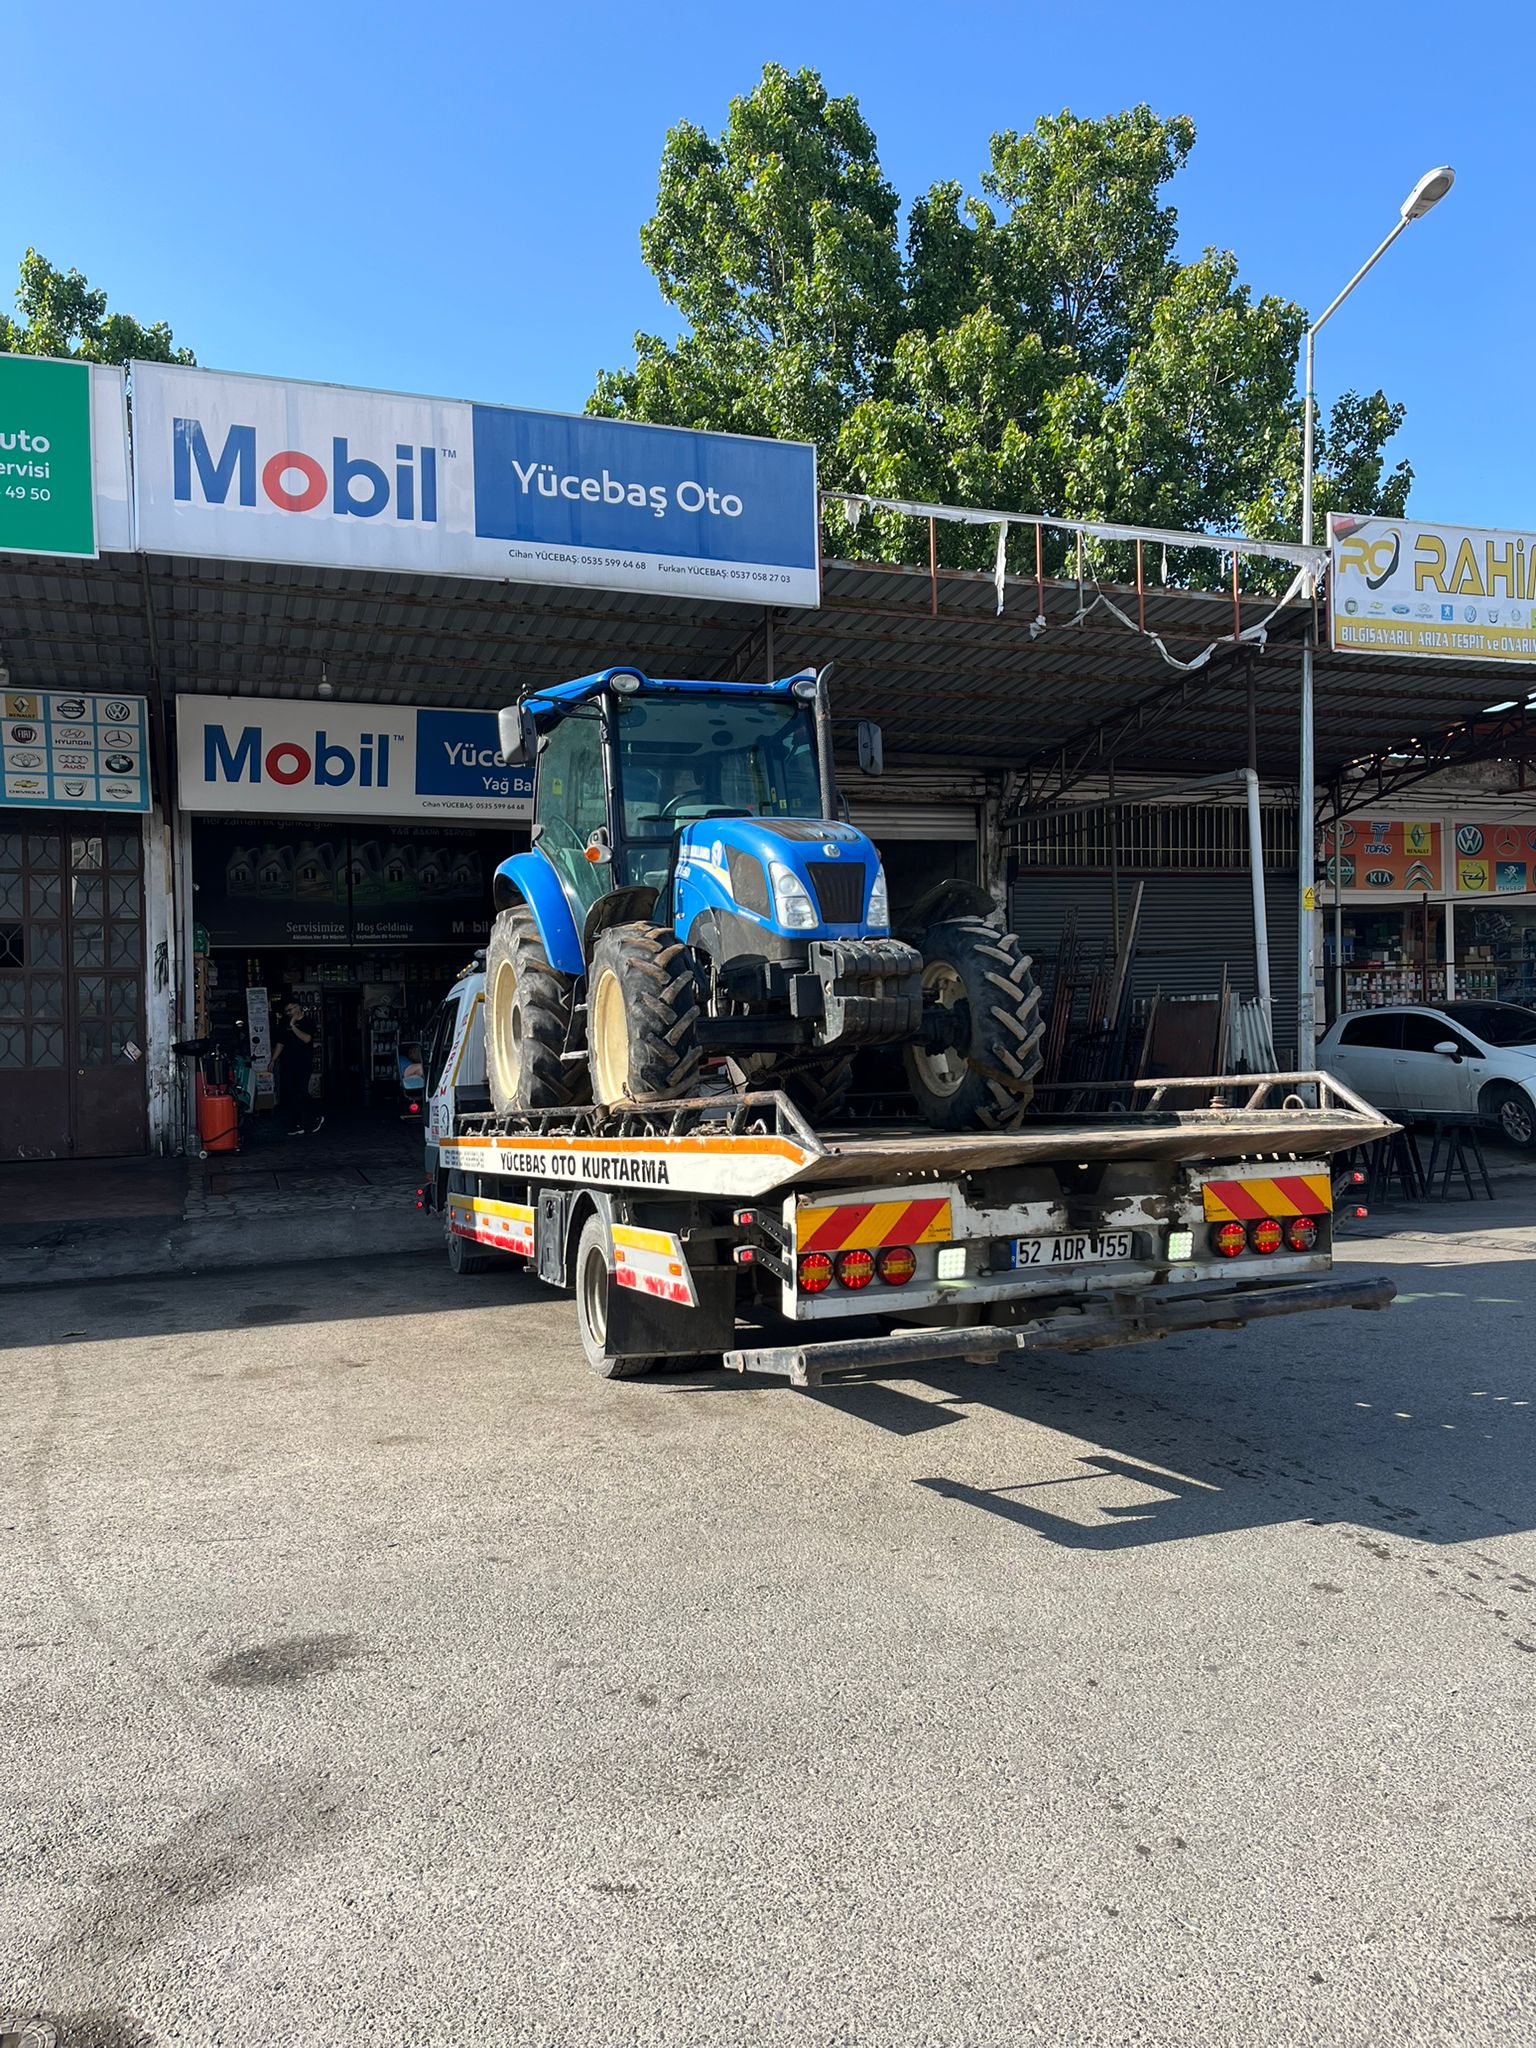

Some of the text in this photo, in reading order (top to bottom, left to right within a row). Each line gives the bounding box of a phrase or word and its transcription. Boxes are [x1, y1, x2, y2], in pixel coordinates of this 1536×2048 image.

[173, 417, 438, 522] Mobil
[5, 486, 51, 501] 49 50
[512, 460, 744, 518] Yücebaş Oto
[508, 549, 647, 570] Cihan YÜCEBAŞ: 0535 599 64 68
[658, 563, 791, 583] Furkan YÜCEBAŞ: 0537 058 27 03
[1418, 631, 1449, 647] ARIZA
[1487, 639, 1499, 650] ve
[17, 728, 31, 739] FIAT
[203, 723, 390, 787] Mobil
[482, 776, 509, 795] Yağ
[1370, 872, 1391, 883] KIA
[286, 921, 415, 934] Servisimize Hoş Geldiniz
[500, 1152, 547, 1176] YÜCEBAŞ
[552, 1155, 576, 1175] OTO
[582, 1156, 670, 1184] KURTARMA
[1019, 1241, 1041, 1264] 52
[1051, 1238, 1086, 1262] ADR
[1099, 1234, 1129, 1258] 155
